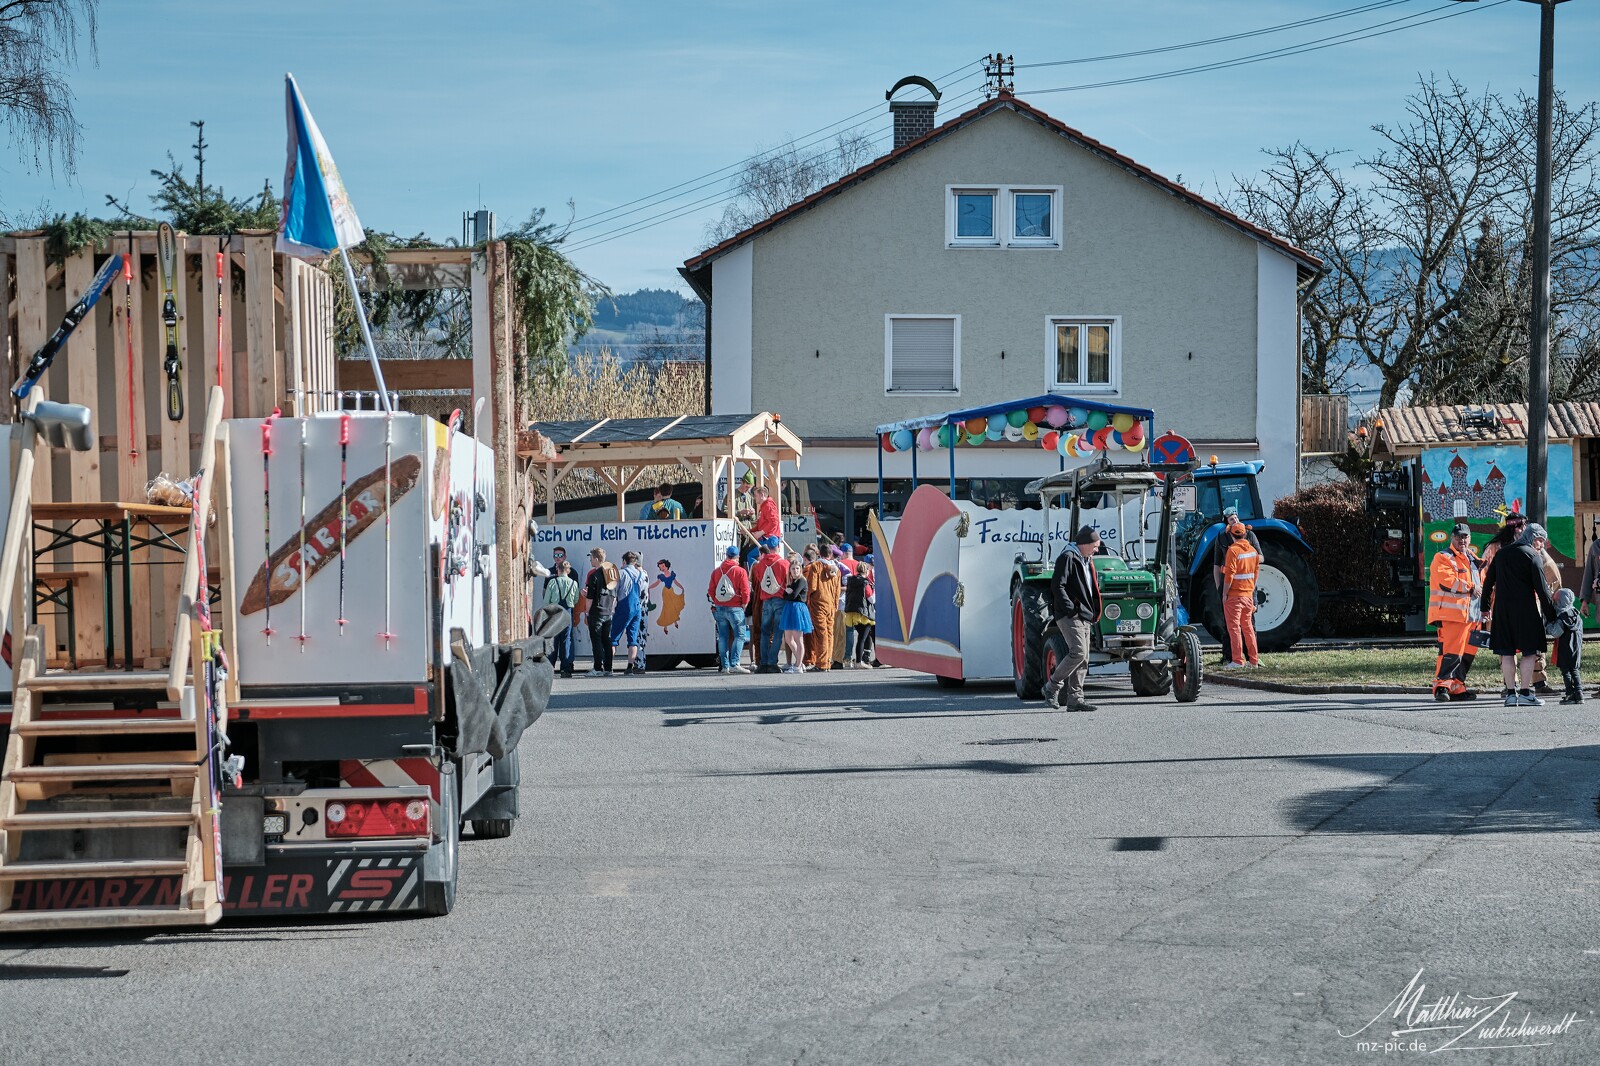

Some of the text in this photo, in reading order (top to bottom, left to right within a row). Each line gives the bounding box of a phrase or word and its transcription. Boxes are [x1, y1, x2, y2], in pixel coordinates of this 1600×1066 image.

[565, 525, 593, 541] und
[600, 524, 627, 541] kein
[633, 524, 708, 540] Tittchen!
